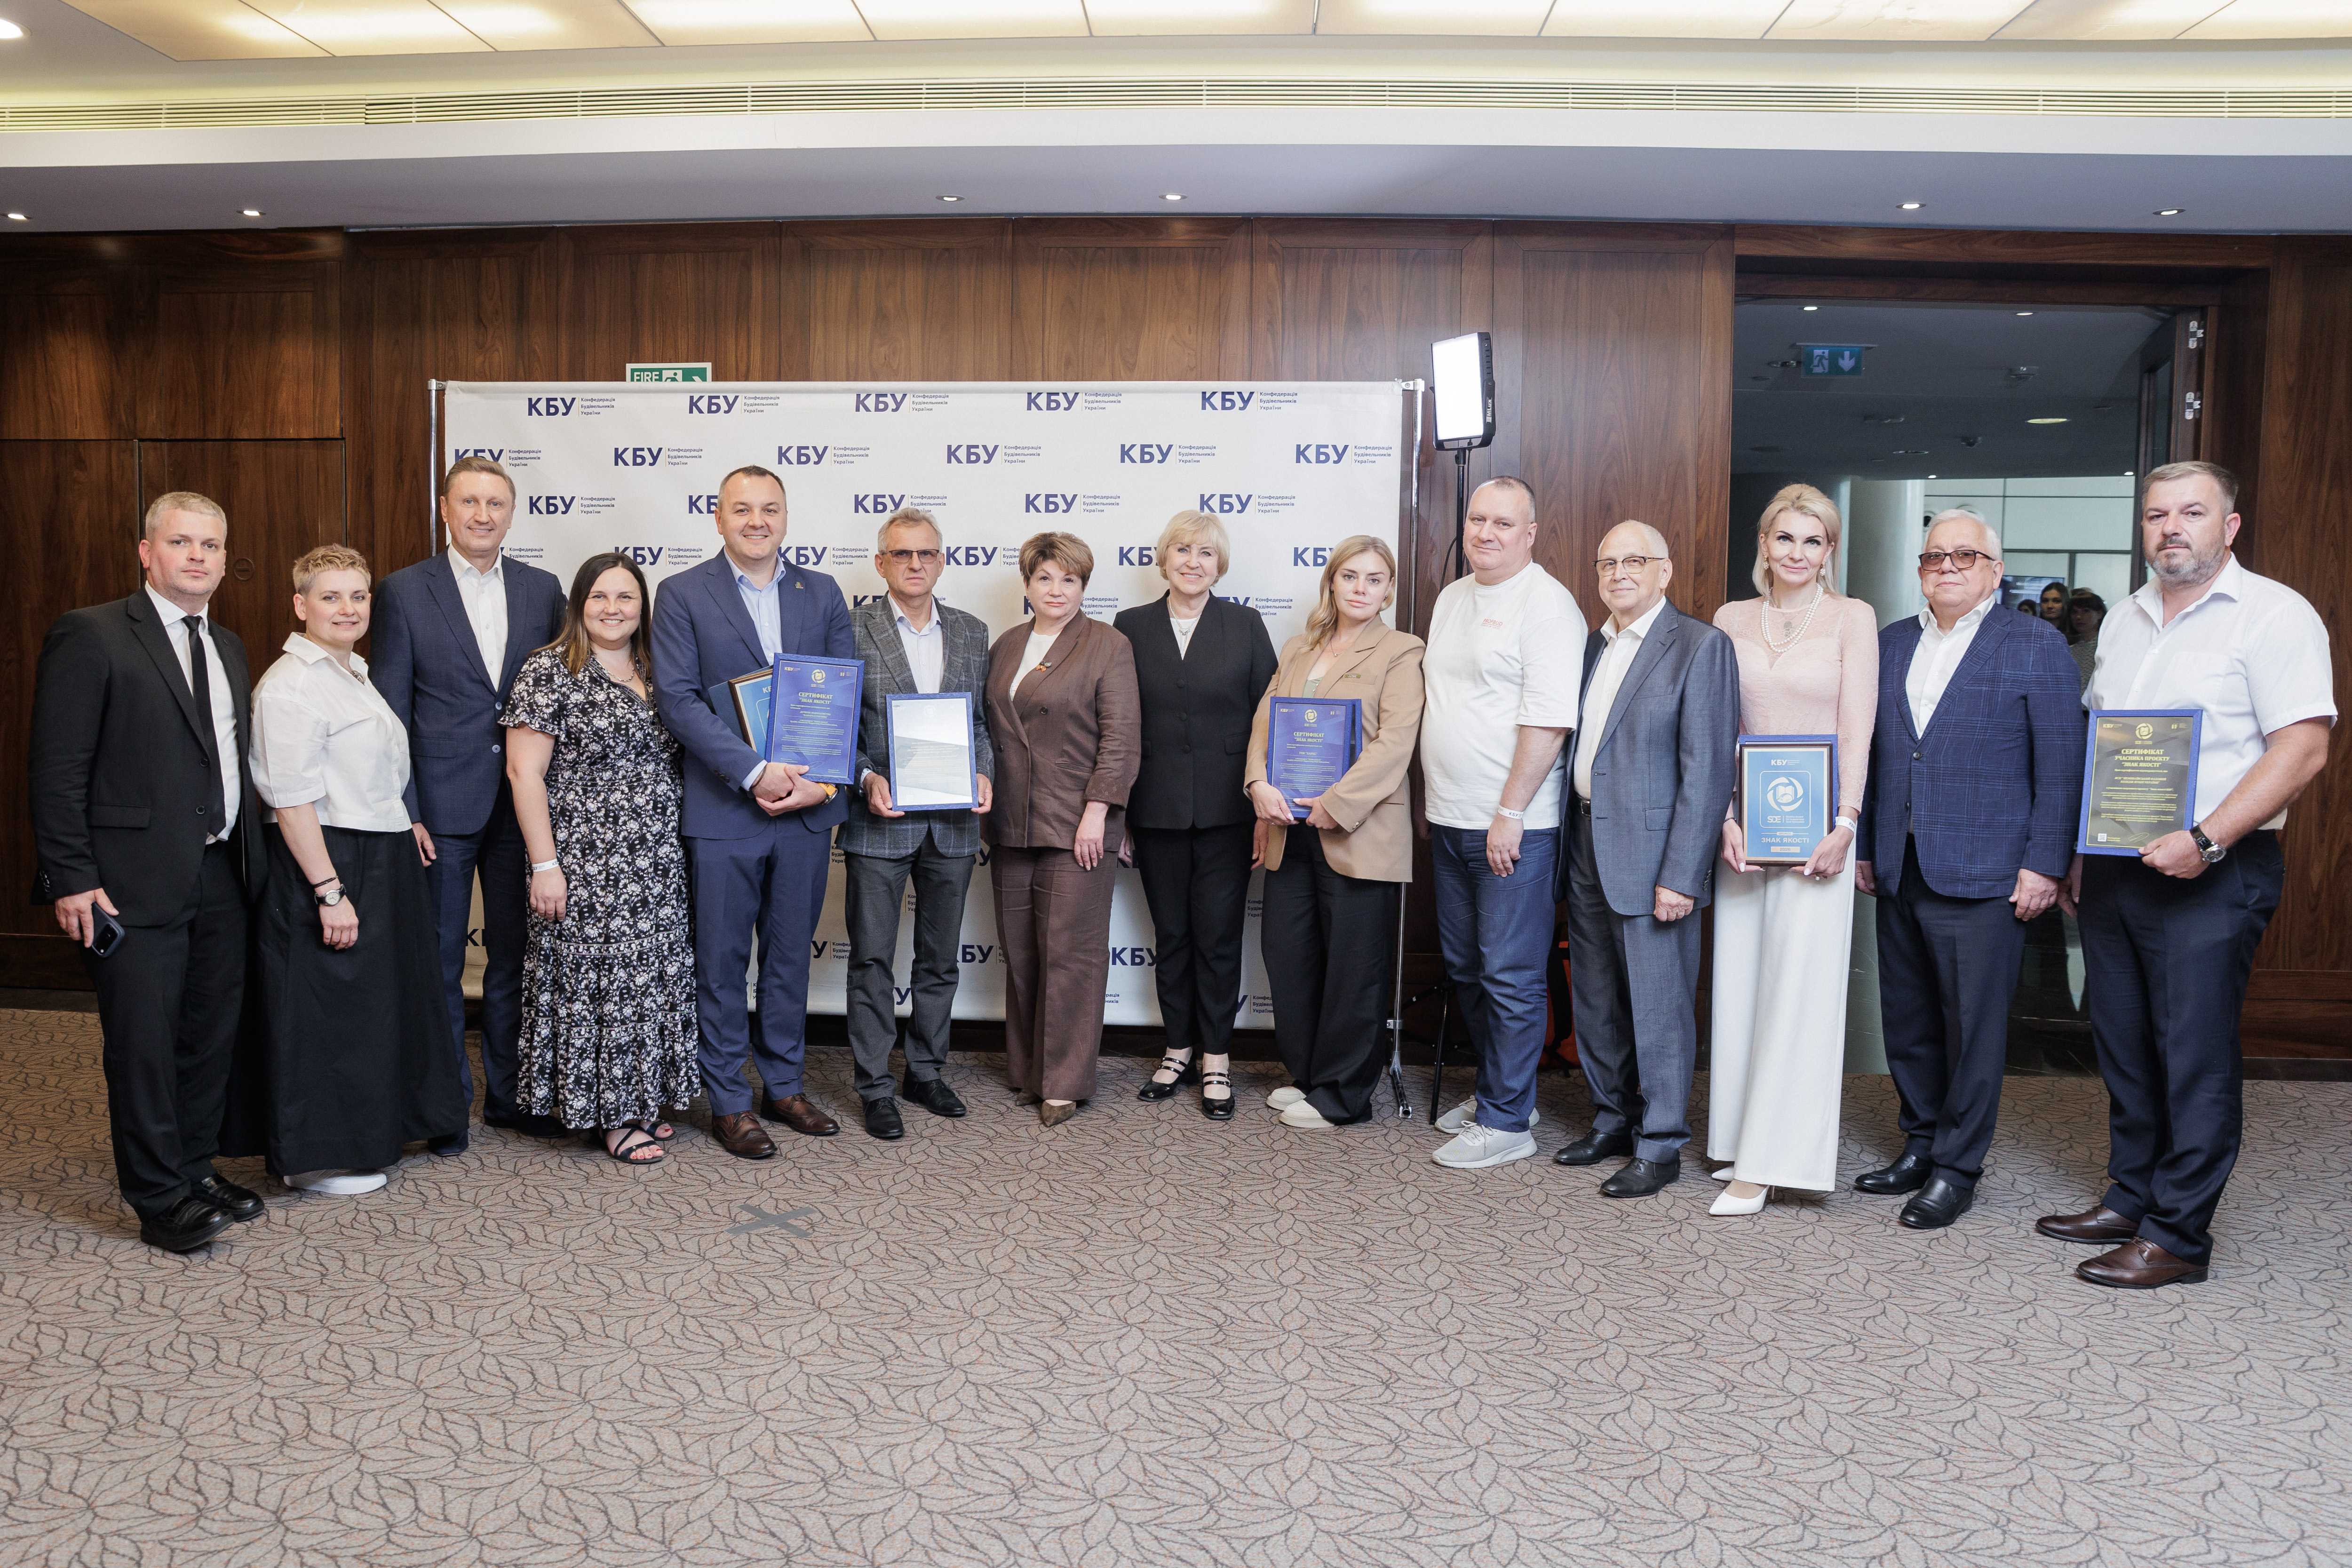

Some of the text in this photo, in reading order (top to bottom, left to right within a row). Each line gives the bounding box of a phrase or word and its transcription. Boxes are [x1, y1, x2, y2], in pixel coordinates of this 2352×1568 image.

[634, 372, 659, 382] FIRE
[528, 398, 576, 416] КБУ
[689, 395, 739, 414] КБУ
[856, 394, 907, 412] КБУ
[1027, 392, 1079, 411] КБУ
[1201, 391, 1255, 410] КБУ
[614, 447, 663, 466] КБУ
[778, 446, 828, 465] КБУ
[947, 445, 999, 464] КБУ
[1120, 444, 1173, 463] КБУ
[1296, 444, 1349, 464] КБУ
[529, 496, 576, 514] КБУ
[689, 495, 718, 514] КБ
[854, 494, 906, 513] КБУ
[1025, 494, 1078, 513] КБУ
[1200, 494, 1253, 513] КБУ
[778, 547, 827, 565] КБУ
[946, 547, 998, 565] КБУ
[1119, 547, 1159, 566] КБ
[1294, 547, 1333, 566] КБ
[957, 945, 994, 963] БУ
